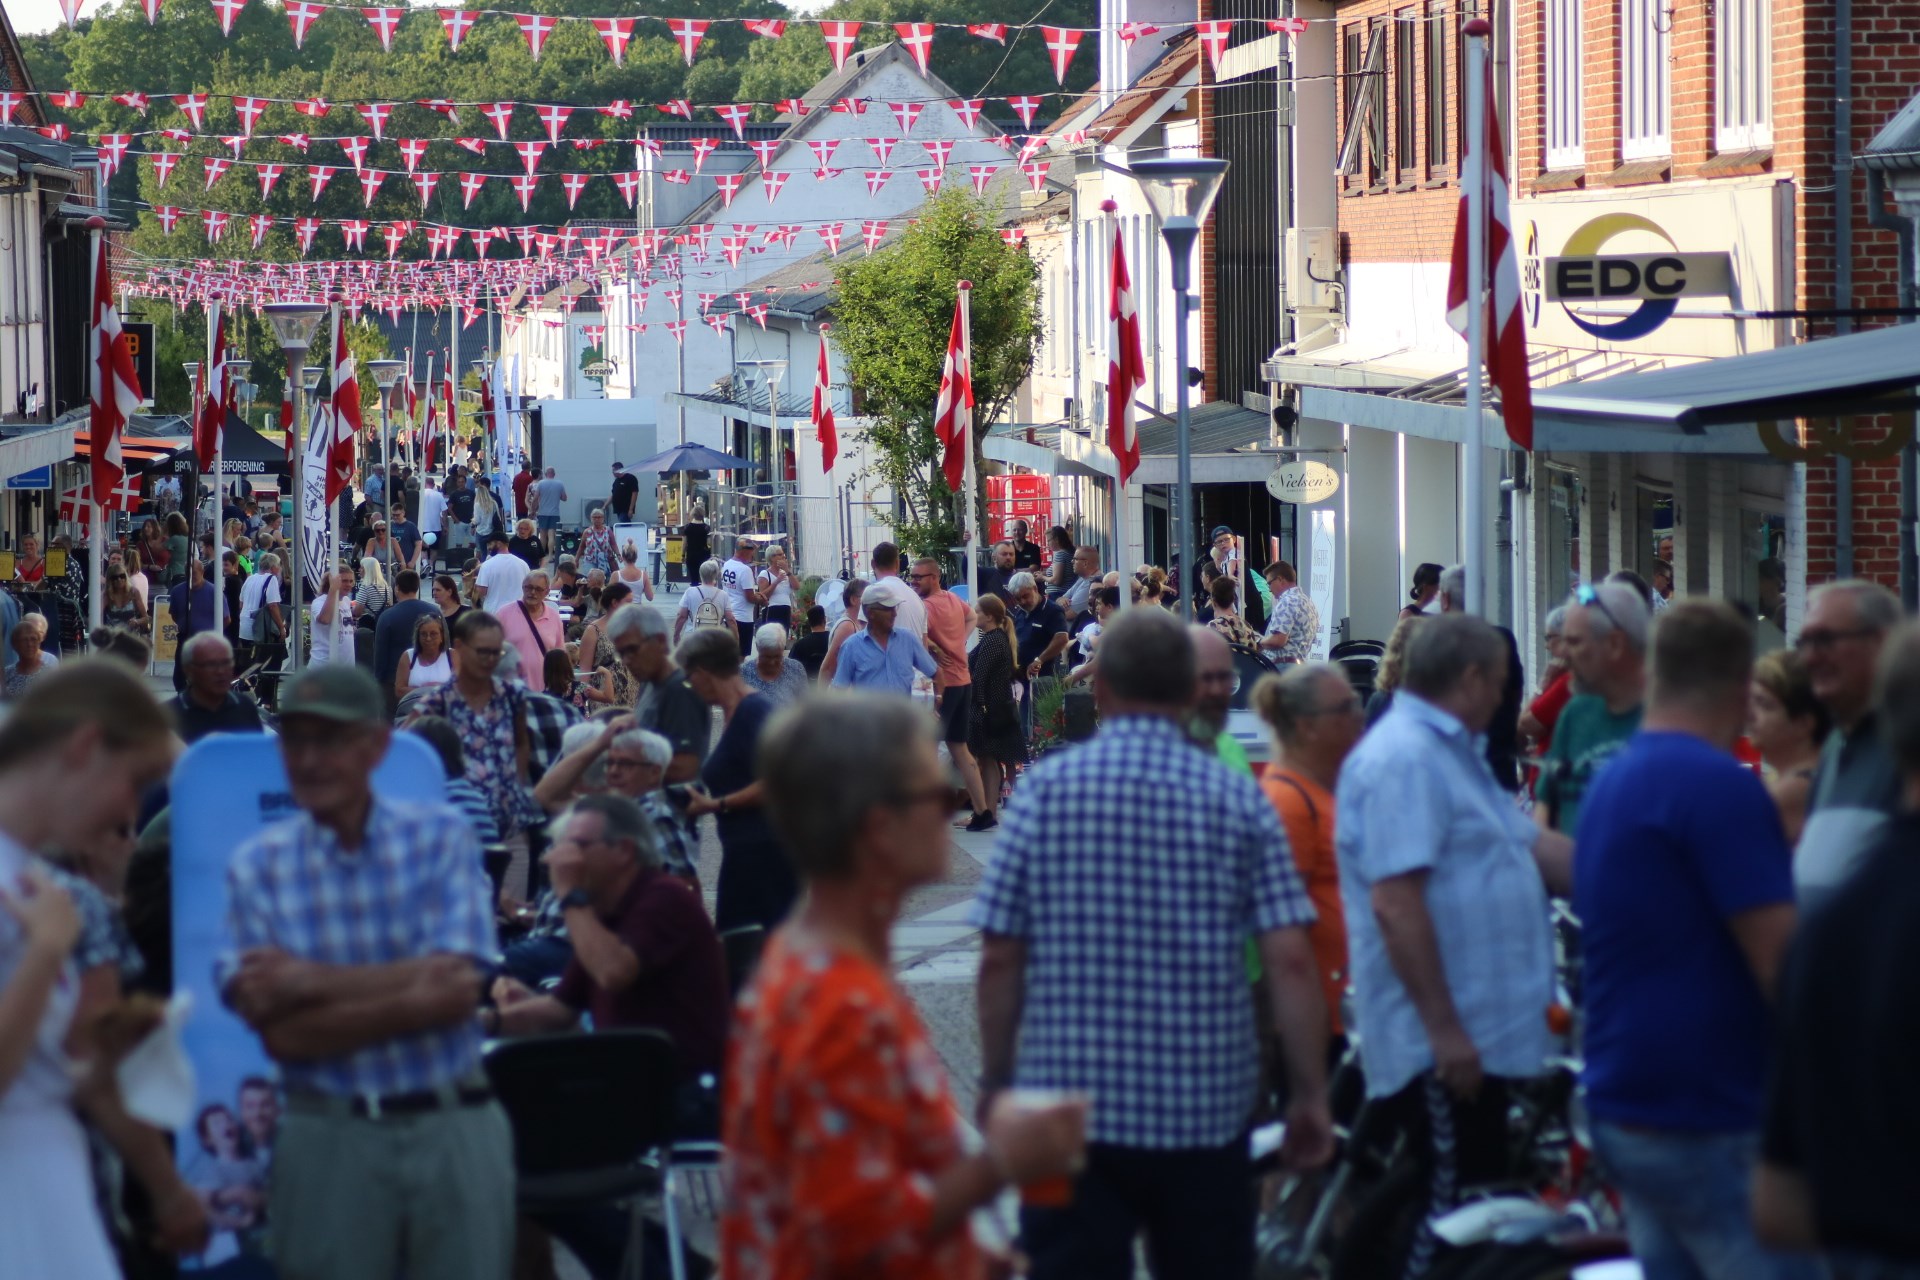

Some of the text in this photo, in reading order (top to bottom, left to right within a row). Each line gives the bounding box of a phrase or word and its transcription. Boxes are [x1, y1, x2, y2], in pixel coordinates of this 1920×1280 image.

[1557, 257, 1686, 297] EDC
[1271, 473, 1333, 488] Nielsen's
[722, 569, 736, 584] ee
